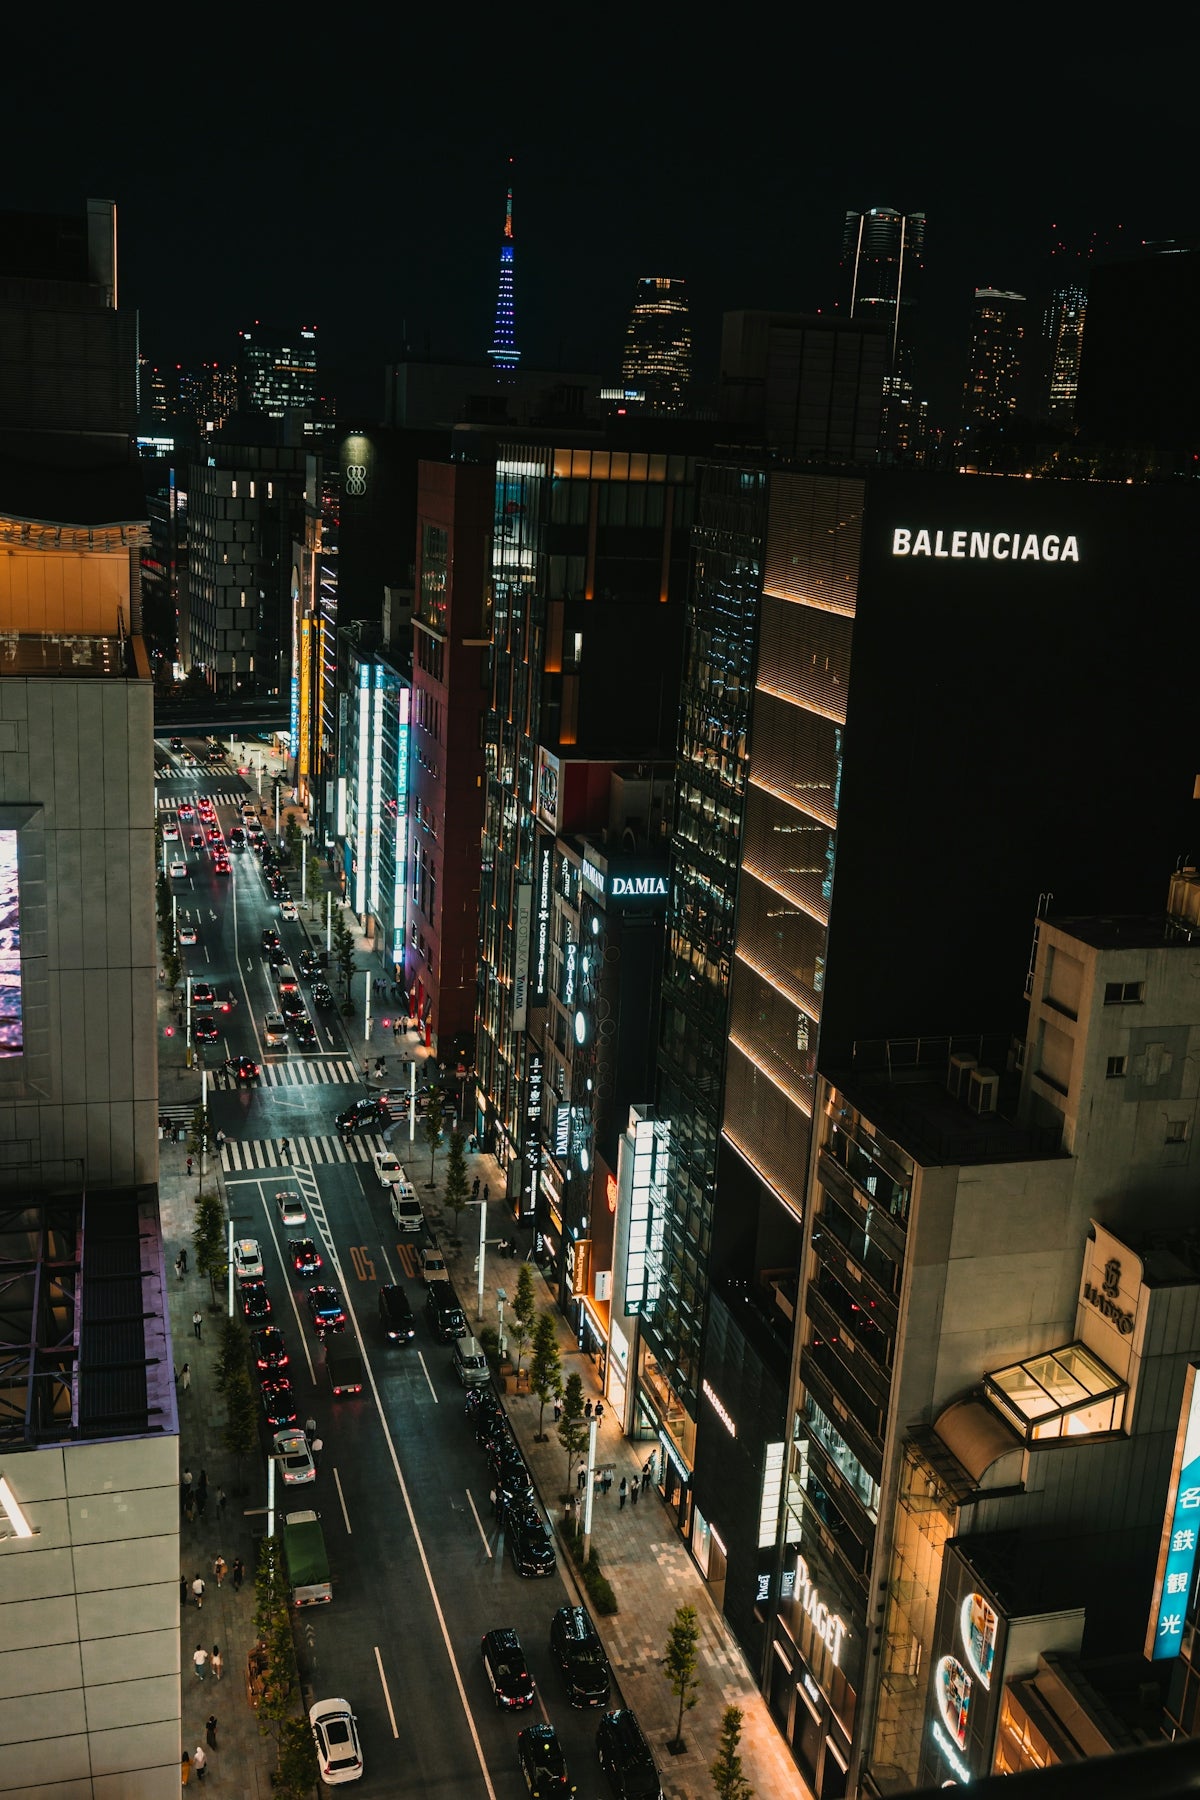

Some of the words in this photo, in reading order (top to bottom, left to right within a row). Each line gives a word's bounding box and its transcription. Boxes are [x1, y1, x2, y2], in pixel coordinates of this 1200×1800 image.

[892, 528, 1079, 562] BALENCIAGA
[541, 850, 550, 908] VACHERON
[518, 926, 528, 965] OTSUKA
[537, 923, 546, 994] CONSTANTIN
[515, 975, 526, 1009] YAMADA
[566, 945, 576, 1003] DAMIANI
[556, 1108, 569, 1155] DAMIANI
[757, 1574, 770, 1600] PIAGET
[1159, 1488, 1200, 1636] 名鉄観光
[794, 1554, 847, 1667] PIAGET
